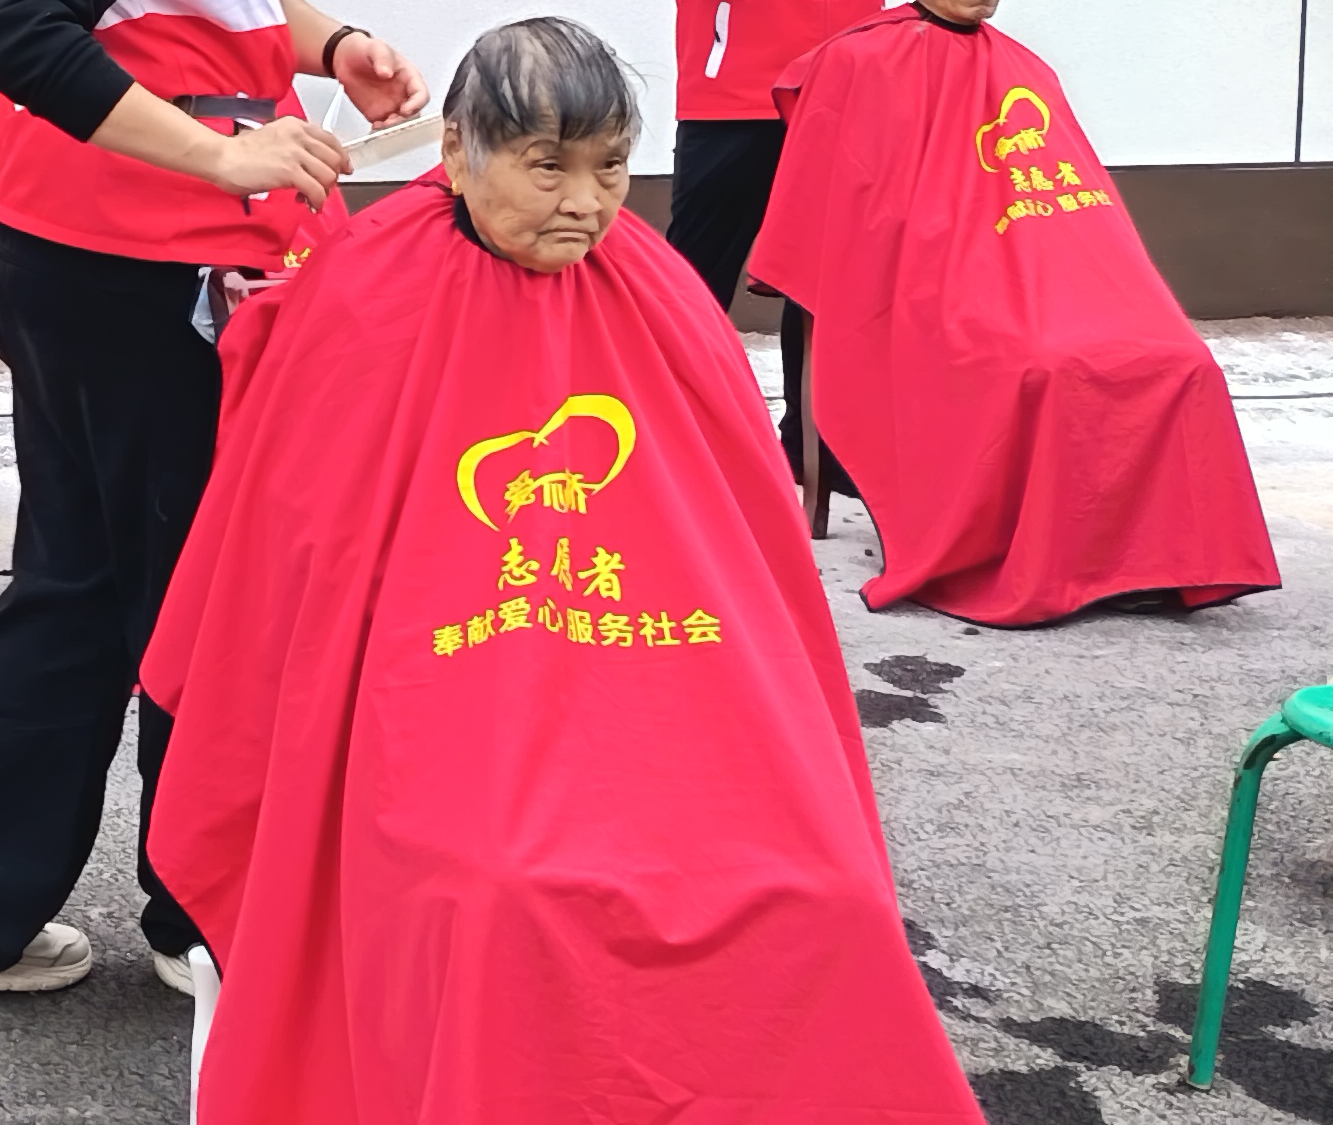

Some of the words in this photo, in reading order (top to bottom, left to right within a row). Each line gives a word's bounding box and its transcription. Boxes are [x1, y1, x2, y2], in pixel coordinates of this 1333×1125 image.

[433, 596, 723, 657] 奉献爱心服务社会
